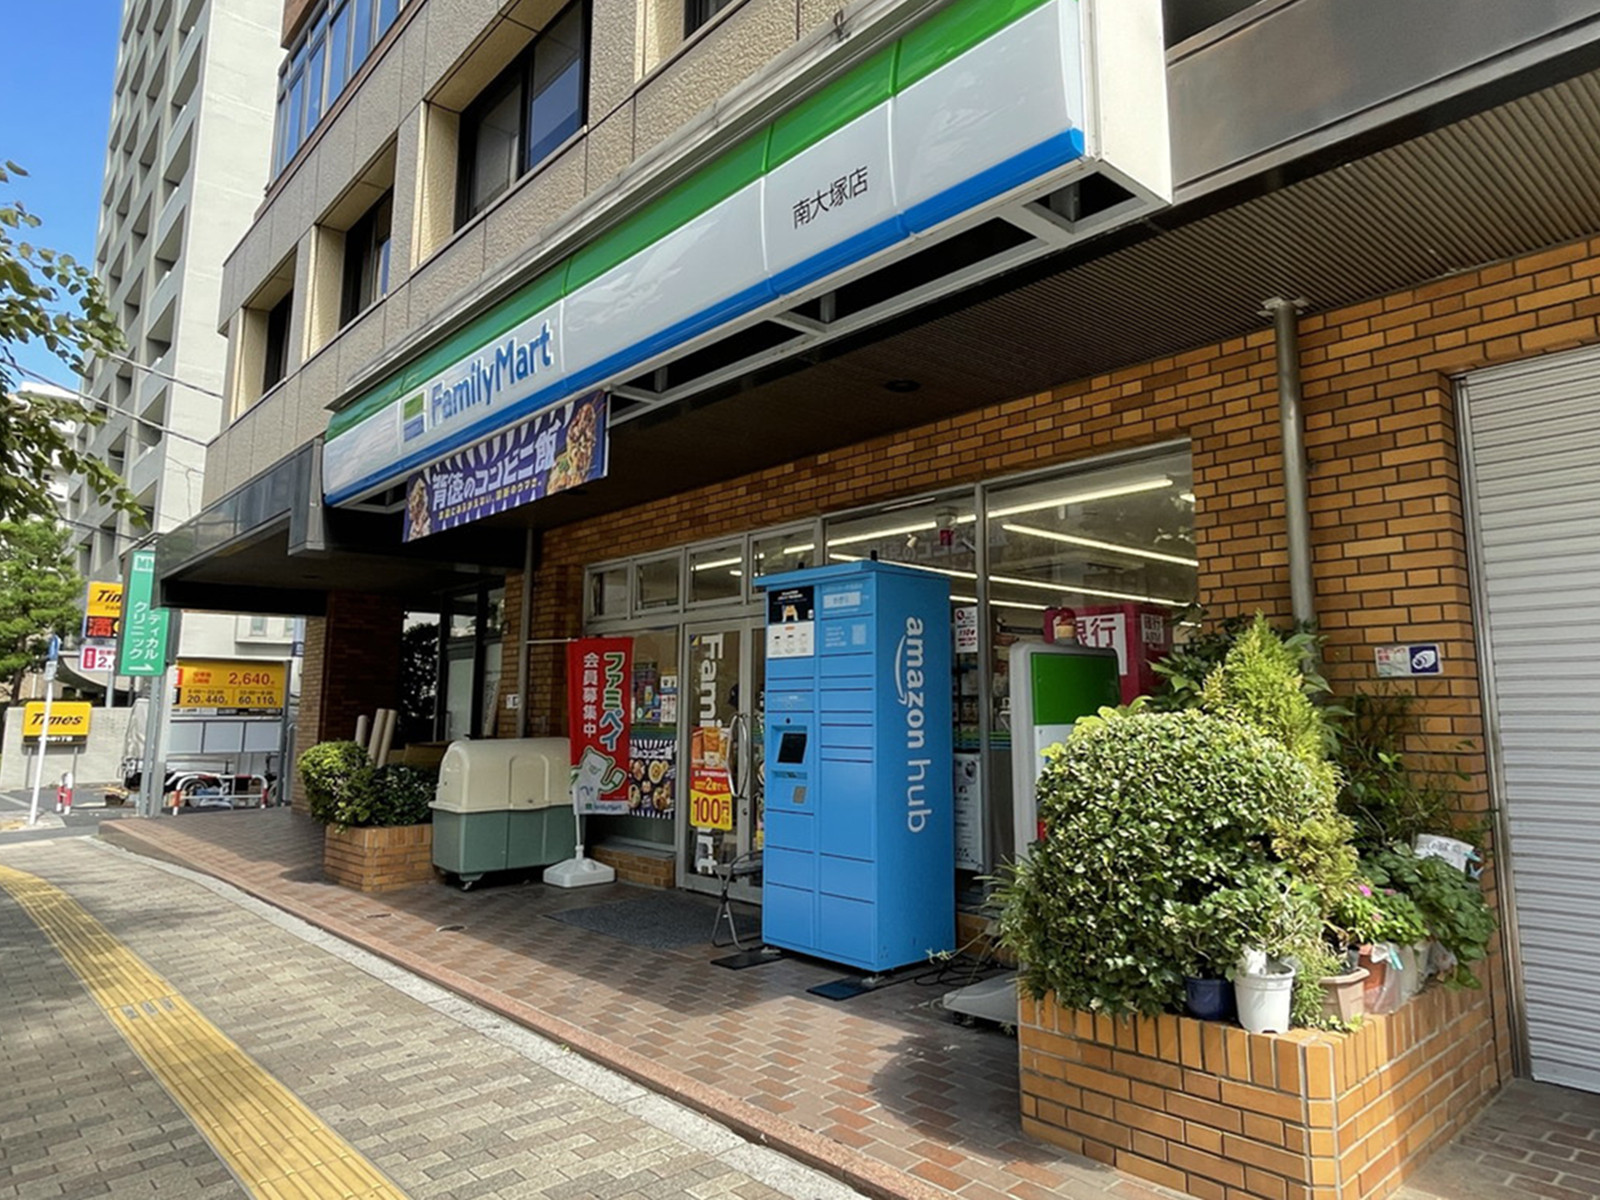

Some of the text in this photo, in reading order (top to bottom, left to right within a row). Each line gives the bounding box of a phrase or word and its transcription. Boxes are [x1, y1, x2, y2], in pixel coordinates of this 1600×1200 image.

[792, 165, 868, 229] 南大塚店
[431, 321, 553, 426] FamilyMart
[432, 420, 561, 511] 背徳のコンビニ飯
[129, 601, 148, 660] クリニック
[144, 611, 162, 660] ディカル
[583, 652, 599, 738] 会員募集中
[600, 652, 625, 752] ファミペイ
[906, 616, 932, 833] amazon hub
